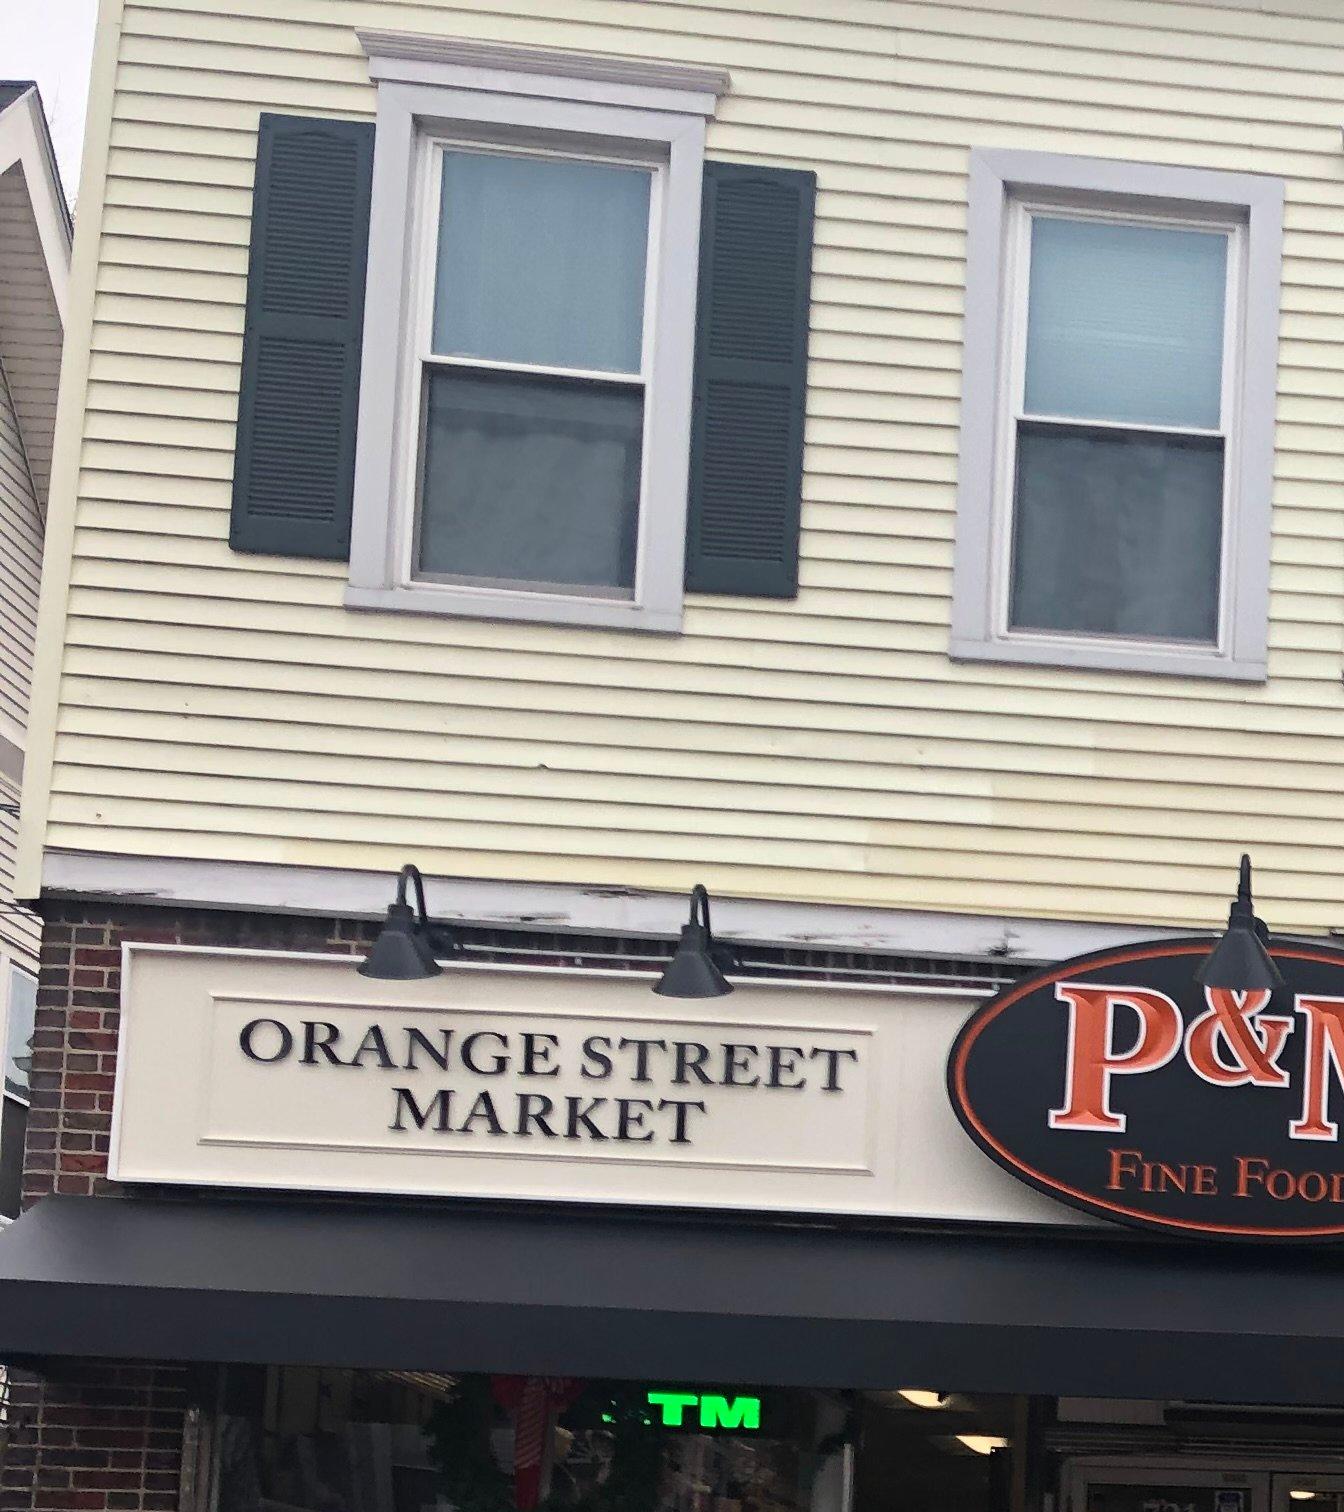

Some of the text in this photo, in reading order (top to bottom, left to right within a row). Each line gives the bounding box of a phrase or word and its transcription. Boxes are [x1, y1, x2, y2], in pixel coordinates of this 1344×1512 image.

[239, 1018, 860, 1092] ORANGE STREET
[388, 1087, 707, 1145] MARKET
[1106, 1149, 1218, 1196] FINE
[602, 1392, 761, 1429] TM
